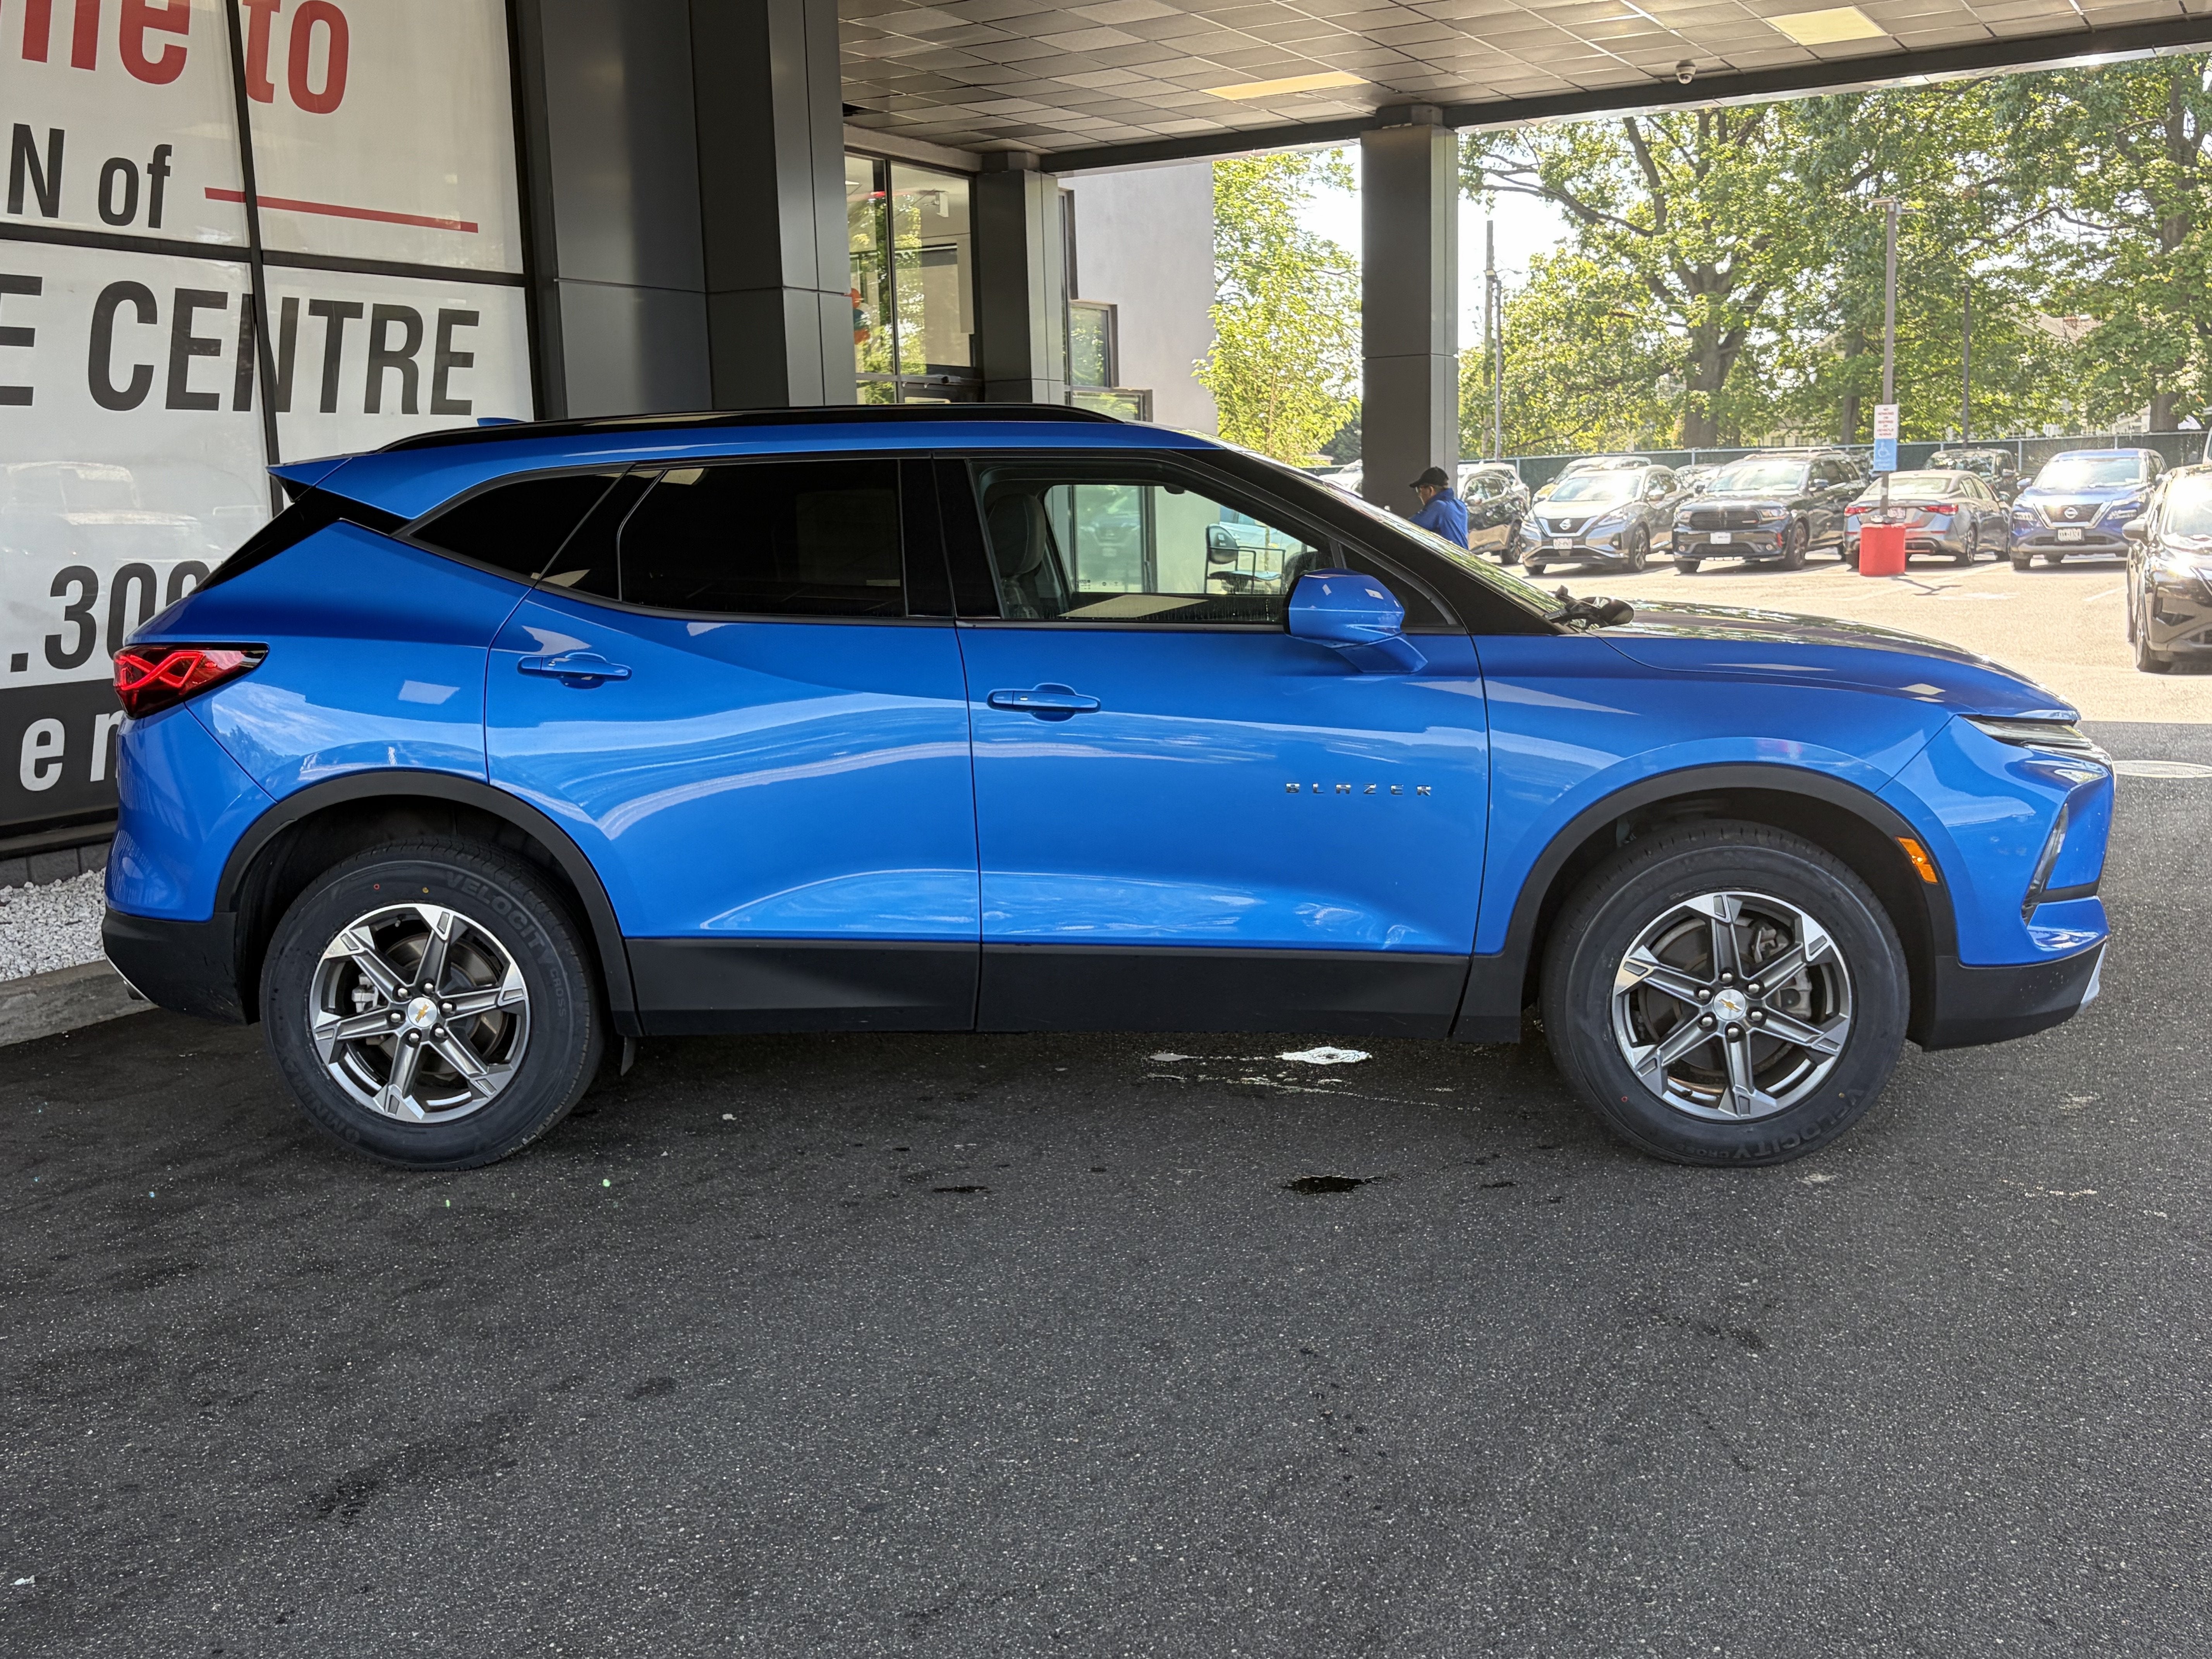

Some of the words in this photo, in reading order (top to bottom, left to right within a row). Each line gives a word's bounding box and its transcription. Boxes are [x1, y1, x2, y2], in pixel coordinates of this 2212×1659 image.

[7, 123, 65, 218] N
[98, 144, 172, 228] of
[88, 280, 479, 416] CENTRE
[1286, 783, 1431, 796] BLAZER
[447, 871, 555, 965] VELOCITY
[550, 969, 567, 1017] CROSS
